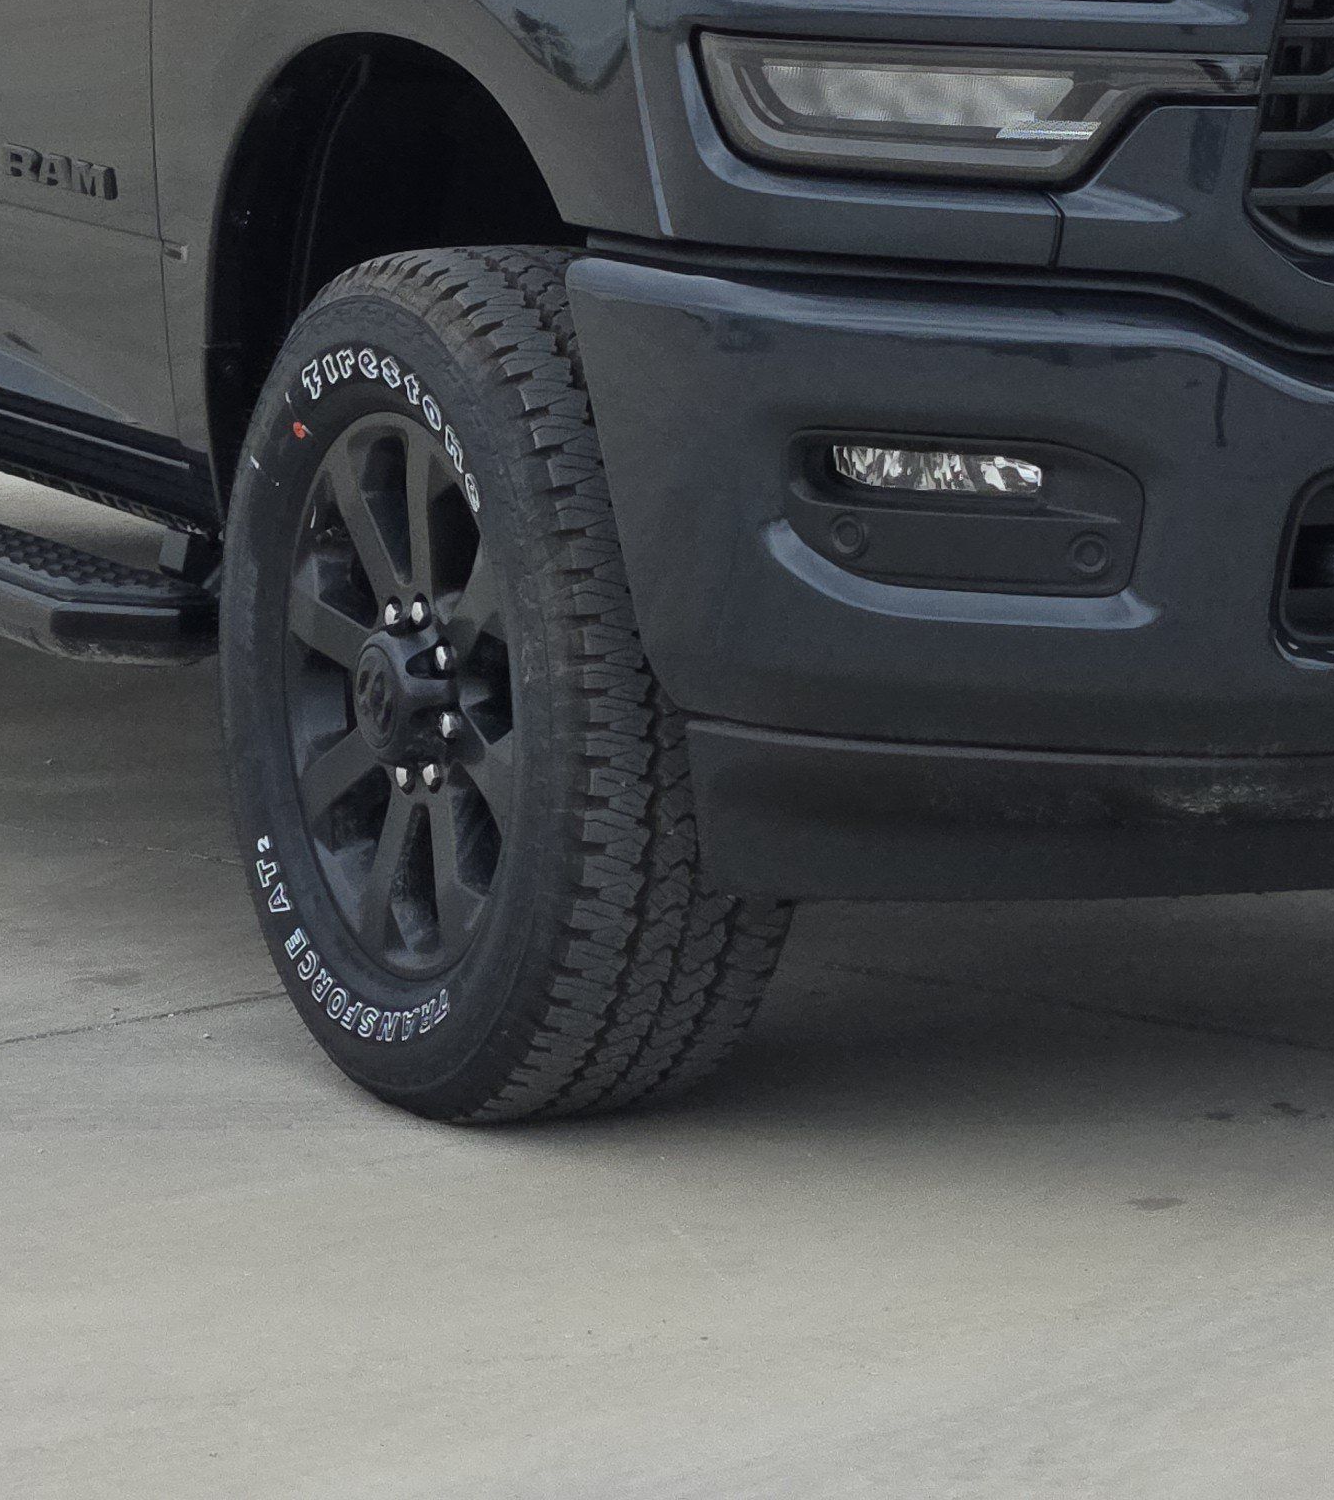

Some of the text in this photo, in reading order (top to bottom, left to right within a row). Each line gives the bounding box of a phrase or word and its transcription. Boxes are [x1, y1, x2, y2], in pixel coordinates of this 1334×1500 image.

[4, 142, 118, 200] RAM
[301, 348, 481, 513] Firestone
[284, 928, 451, 1042] TRANSFORCE
